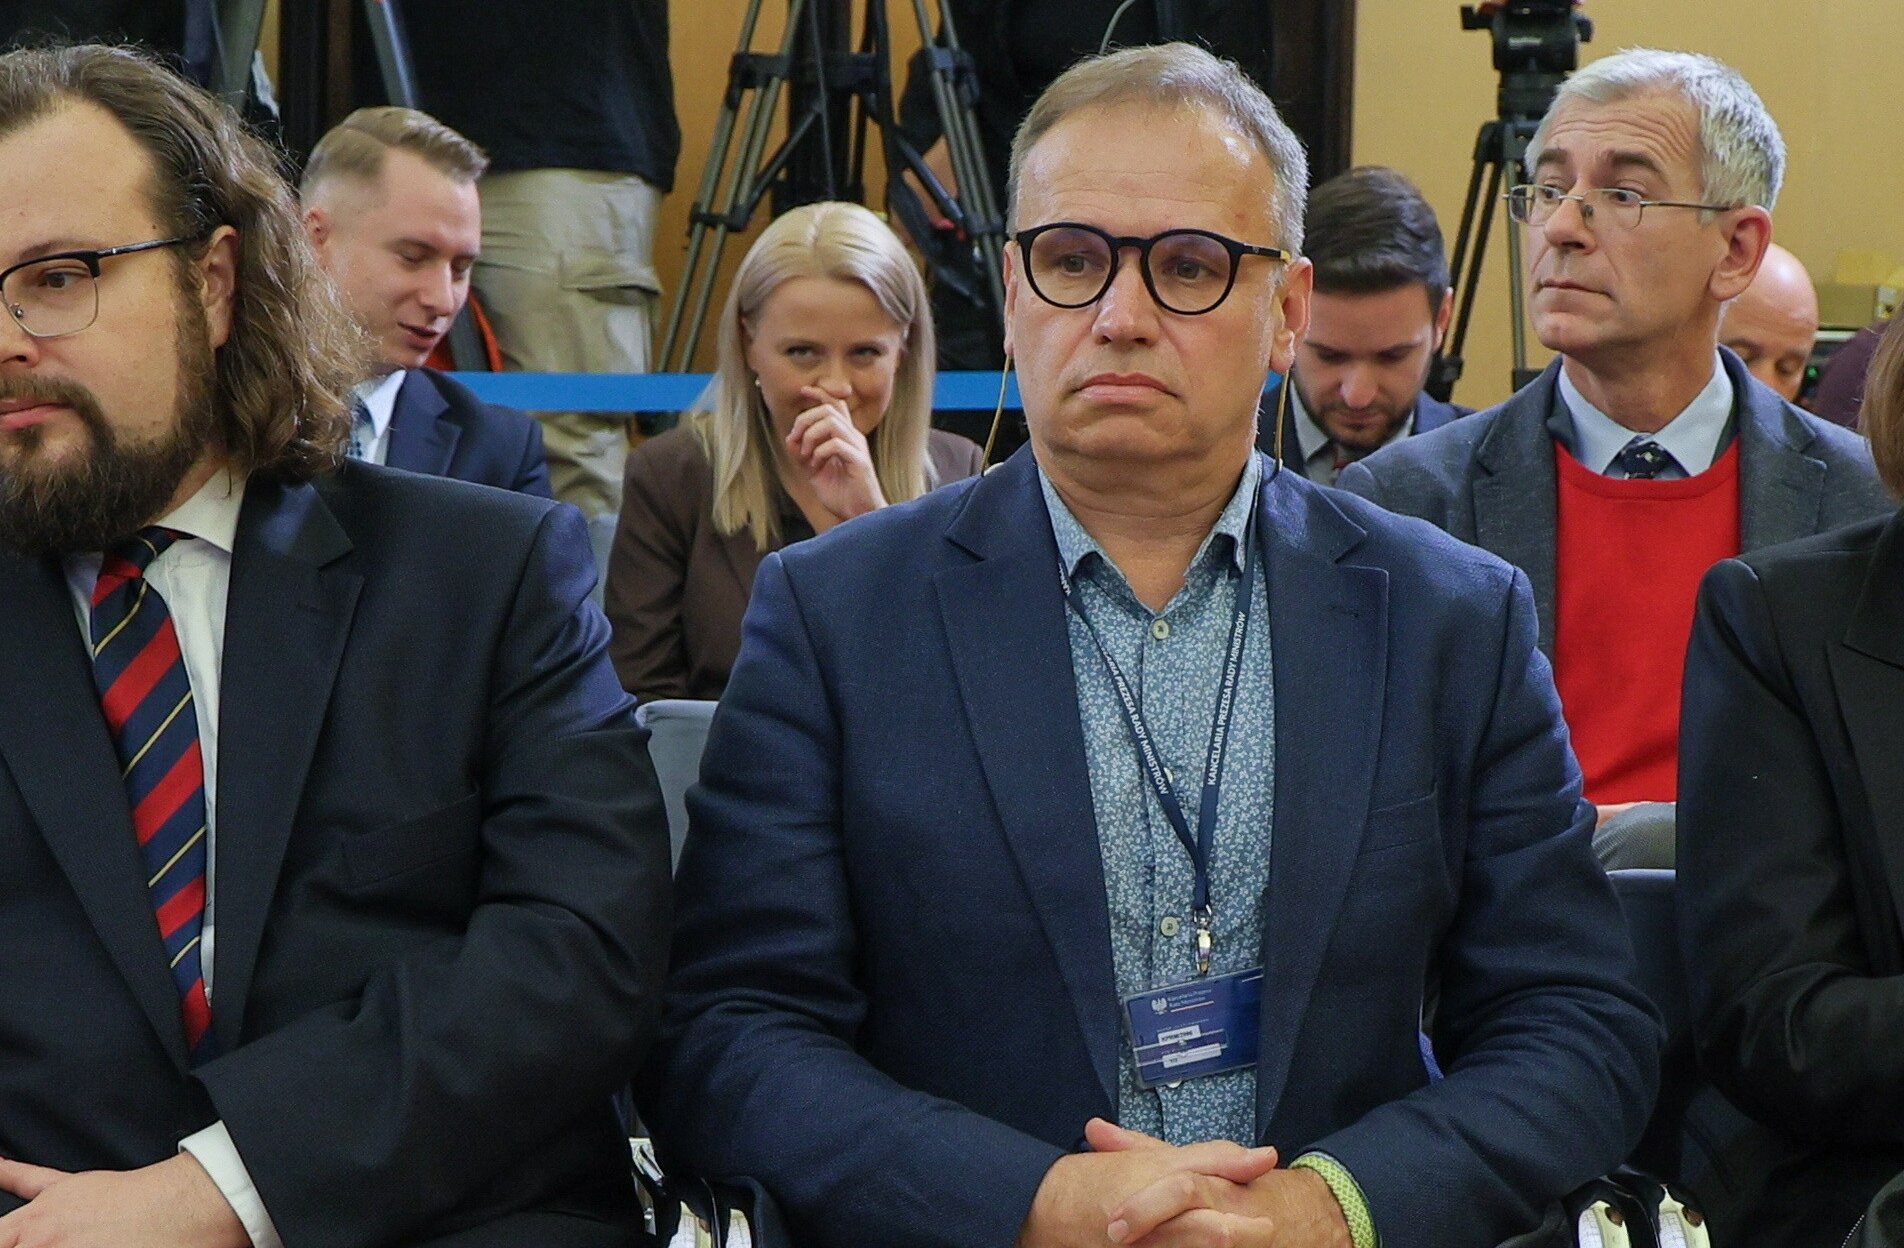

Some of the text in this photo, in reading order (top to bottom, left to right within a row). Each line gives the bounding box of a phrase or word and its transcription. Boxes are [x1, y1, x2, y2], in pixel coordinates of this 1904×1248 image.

[1114, 676, 1136, 715] PREZESA
[1130, 713, 1147, 739] RADY
[1207, 726, 1225, 785] KANCELARIA
[1217, 687, 1233, 725] PREZESA
[1225, 661, 1236, 687] RADY
